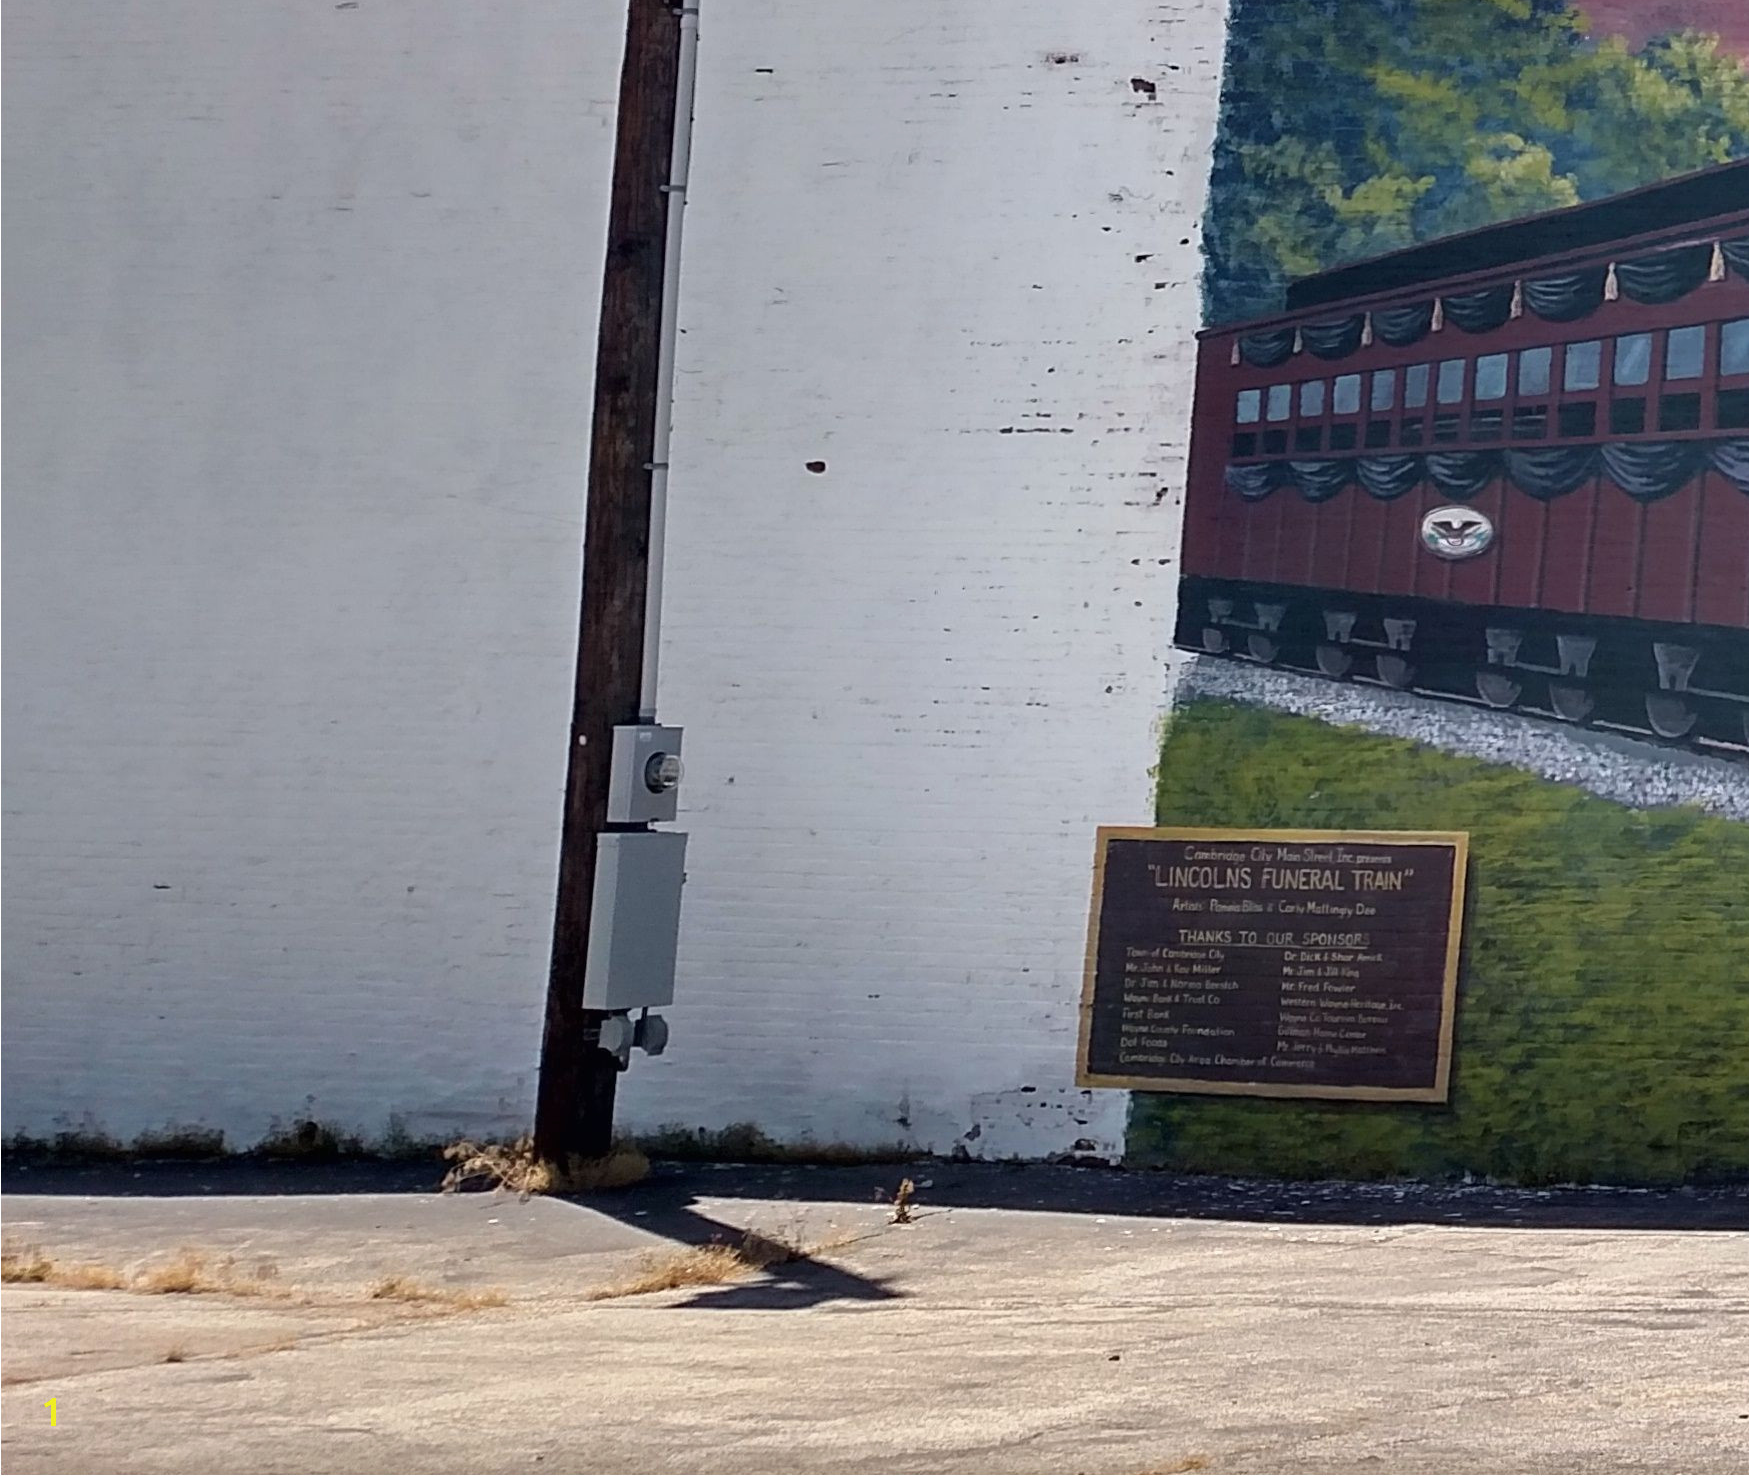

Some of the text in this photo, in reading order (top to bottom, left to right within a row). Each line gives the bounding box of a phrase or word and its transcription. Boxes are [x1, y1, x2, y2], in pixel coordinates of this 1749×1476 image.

[1184, 845, 1246, 866] Cambridge
[1250, 846, 1274, 865] City
[1277, 847, 1301, 862] Main
[1261, 867, 1345, 891] FUNERAL
[1355, 903, 1377, 916] Dee
[1178, 929, 1370, 947] THANKS TO OUR SPONSORS
[1192, 964, 1221, 974] Miller
[1298, 982, 1320, 992] Fred
[1182, 1024, 1236, 1037] Foundation
